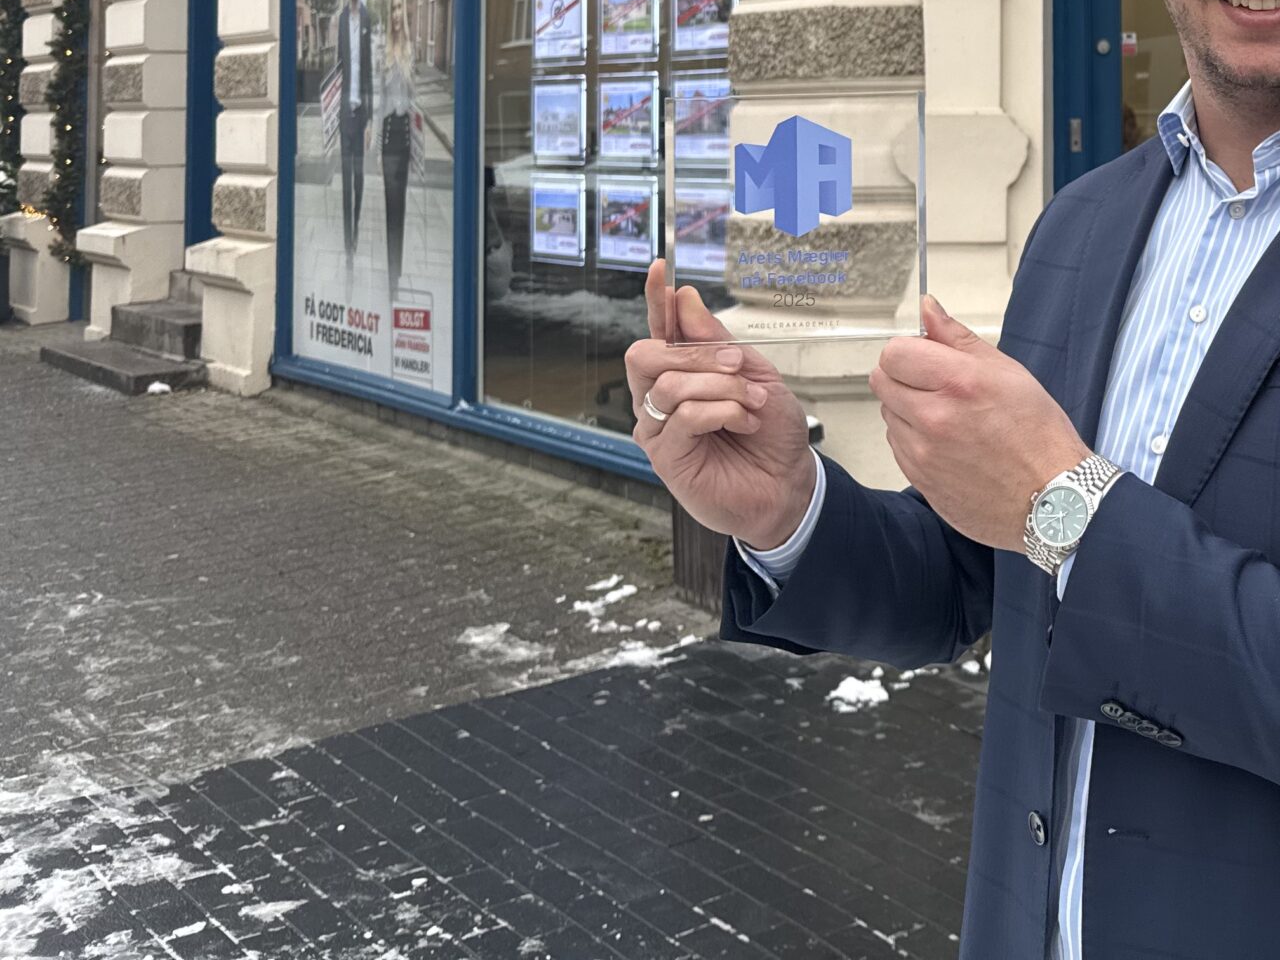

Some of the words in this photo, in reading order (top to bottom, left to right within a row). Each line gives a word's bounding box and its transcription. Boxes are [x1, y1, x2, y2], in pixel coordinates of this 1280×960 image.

[738, 248, 783, 265] Årets
[788, 249, 849, 265] Mægler
[741, 271, 761, 288] på
[768, 270, 846, 287] Facebook
[773, 292, 816, 308] 2025
[305, 292, 317, 317] FÅ
[318, 300, 345, 325] GODT
[347, 307, 380, 335] SOLGT
[310, 321, 314, 340] I
[316, 322, 374, 357] FREDERICIA
